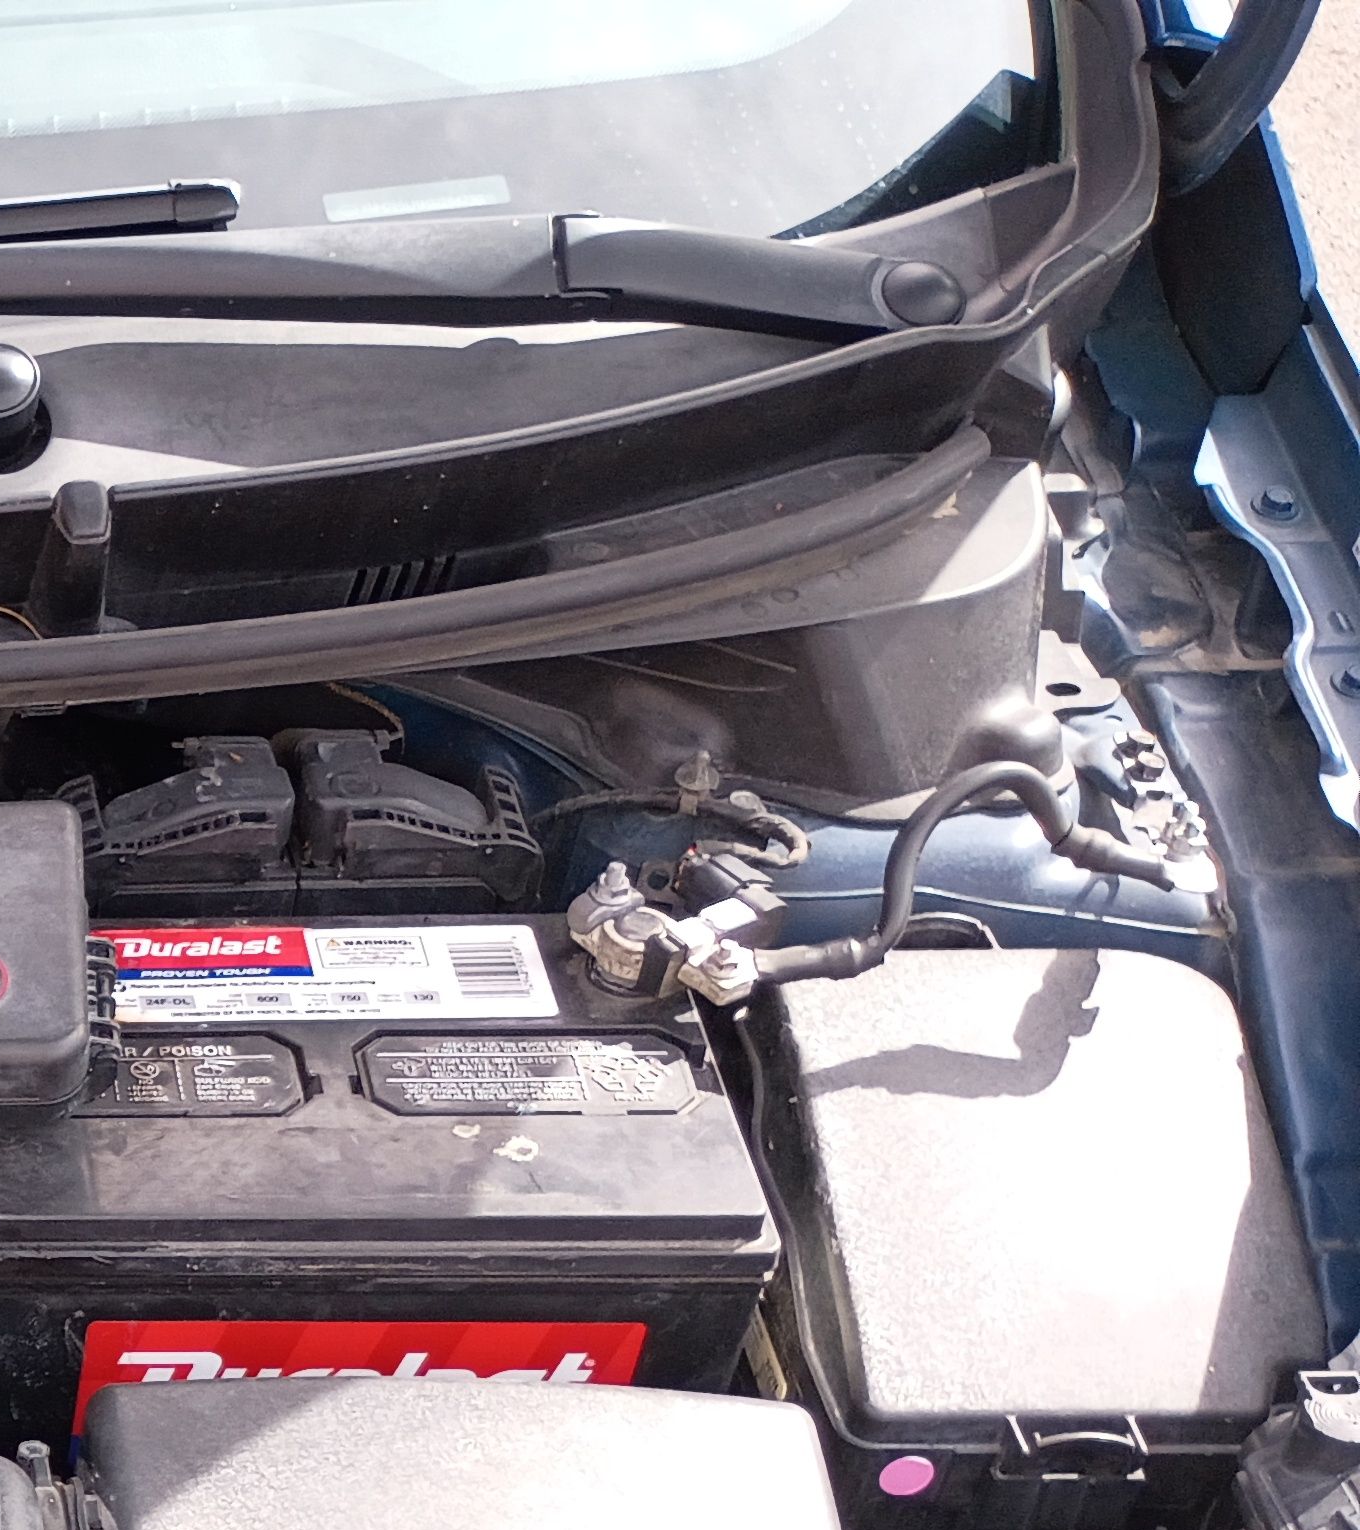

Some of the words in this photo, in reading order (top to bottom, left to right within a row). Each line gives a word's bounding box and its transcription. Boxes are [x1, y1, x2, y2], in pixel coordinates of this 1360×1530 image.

[114, 935, 282, 958] Duralast
[140, 968, 209, 978] PROVEN
[214, 967, 272, 977] TOUGH
[159, 1045, 232, 1057] POISON
